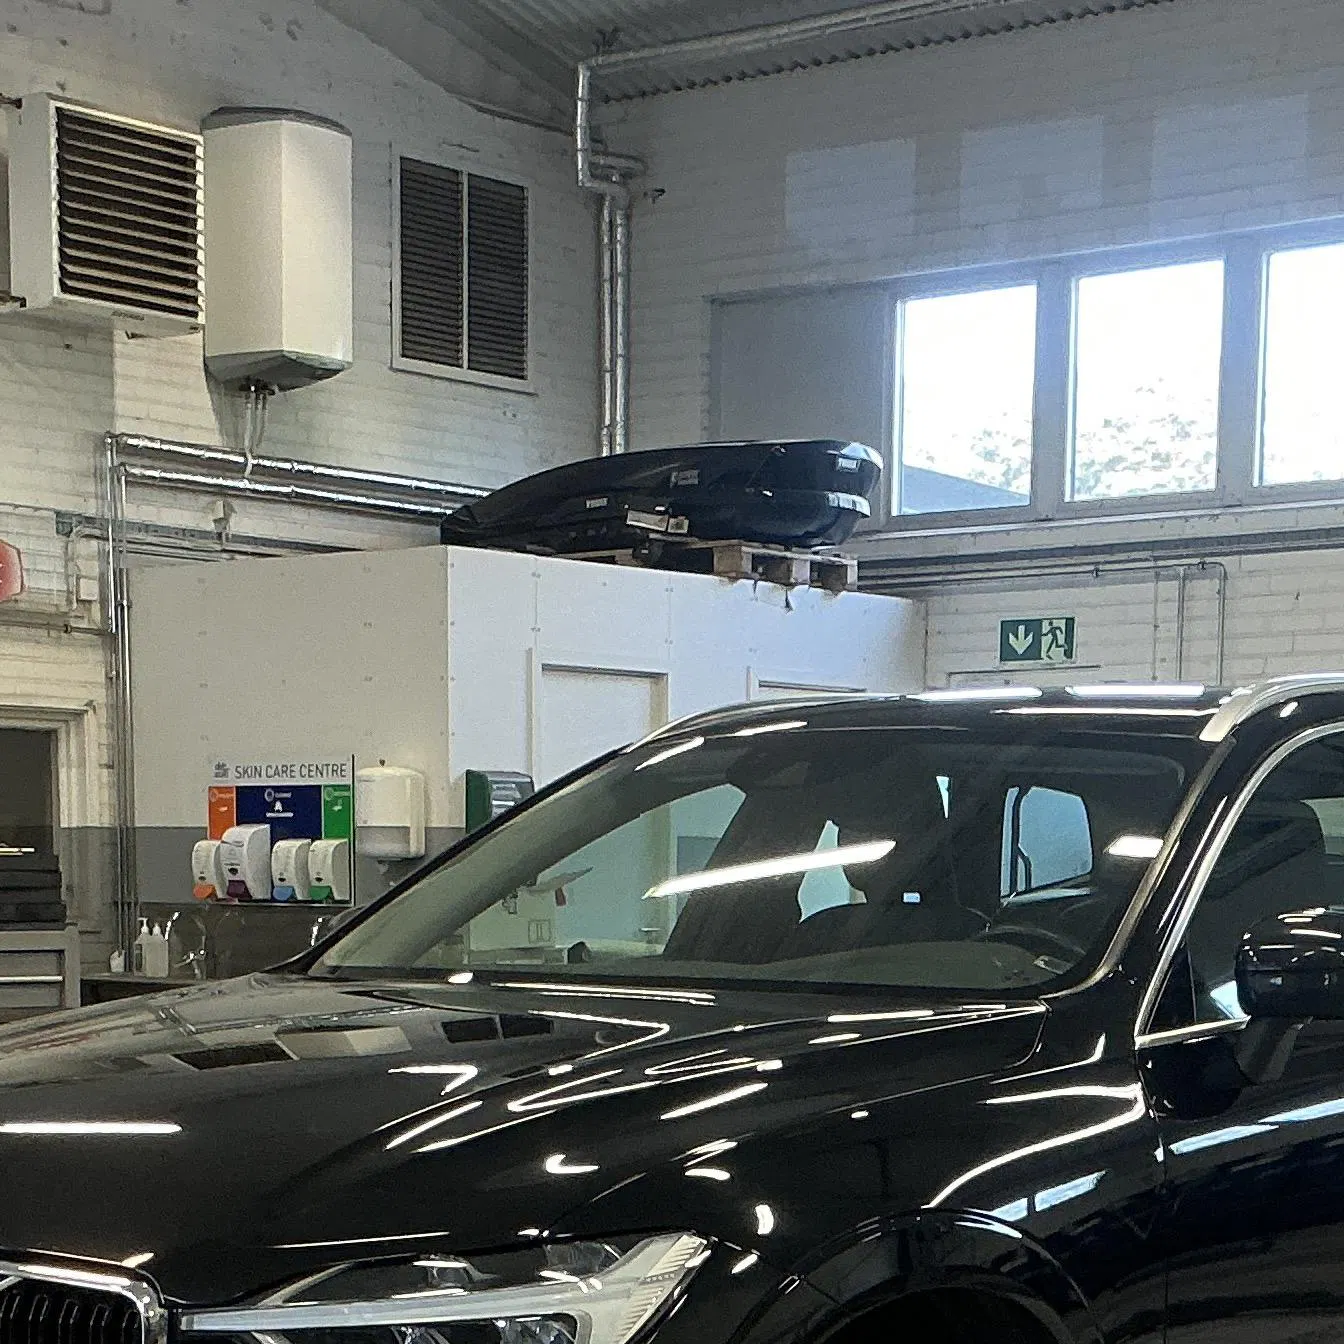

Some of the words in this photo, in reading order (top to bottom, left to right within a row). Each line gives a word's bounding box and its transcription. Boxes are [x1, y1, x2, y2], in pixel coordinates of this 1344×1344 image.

[235, 765, 262, 779] SKIN
[265, 764, 297, 778] CARE
[299, 763, 347, 778] CENTRE
